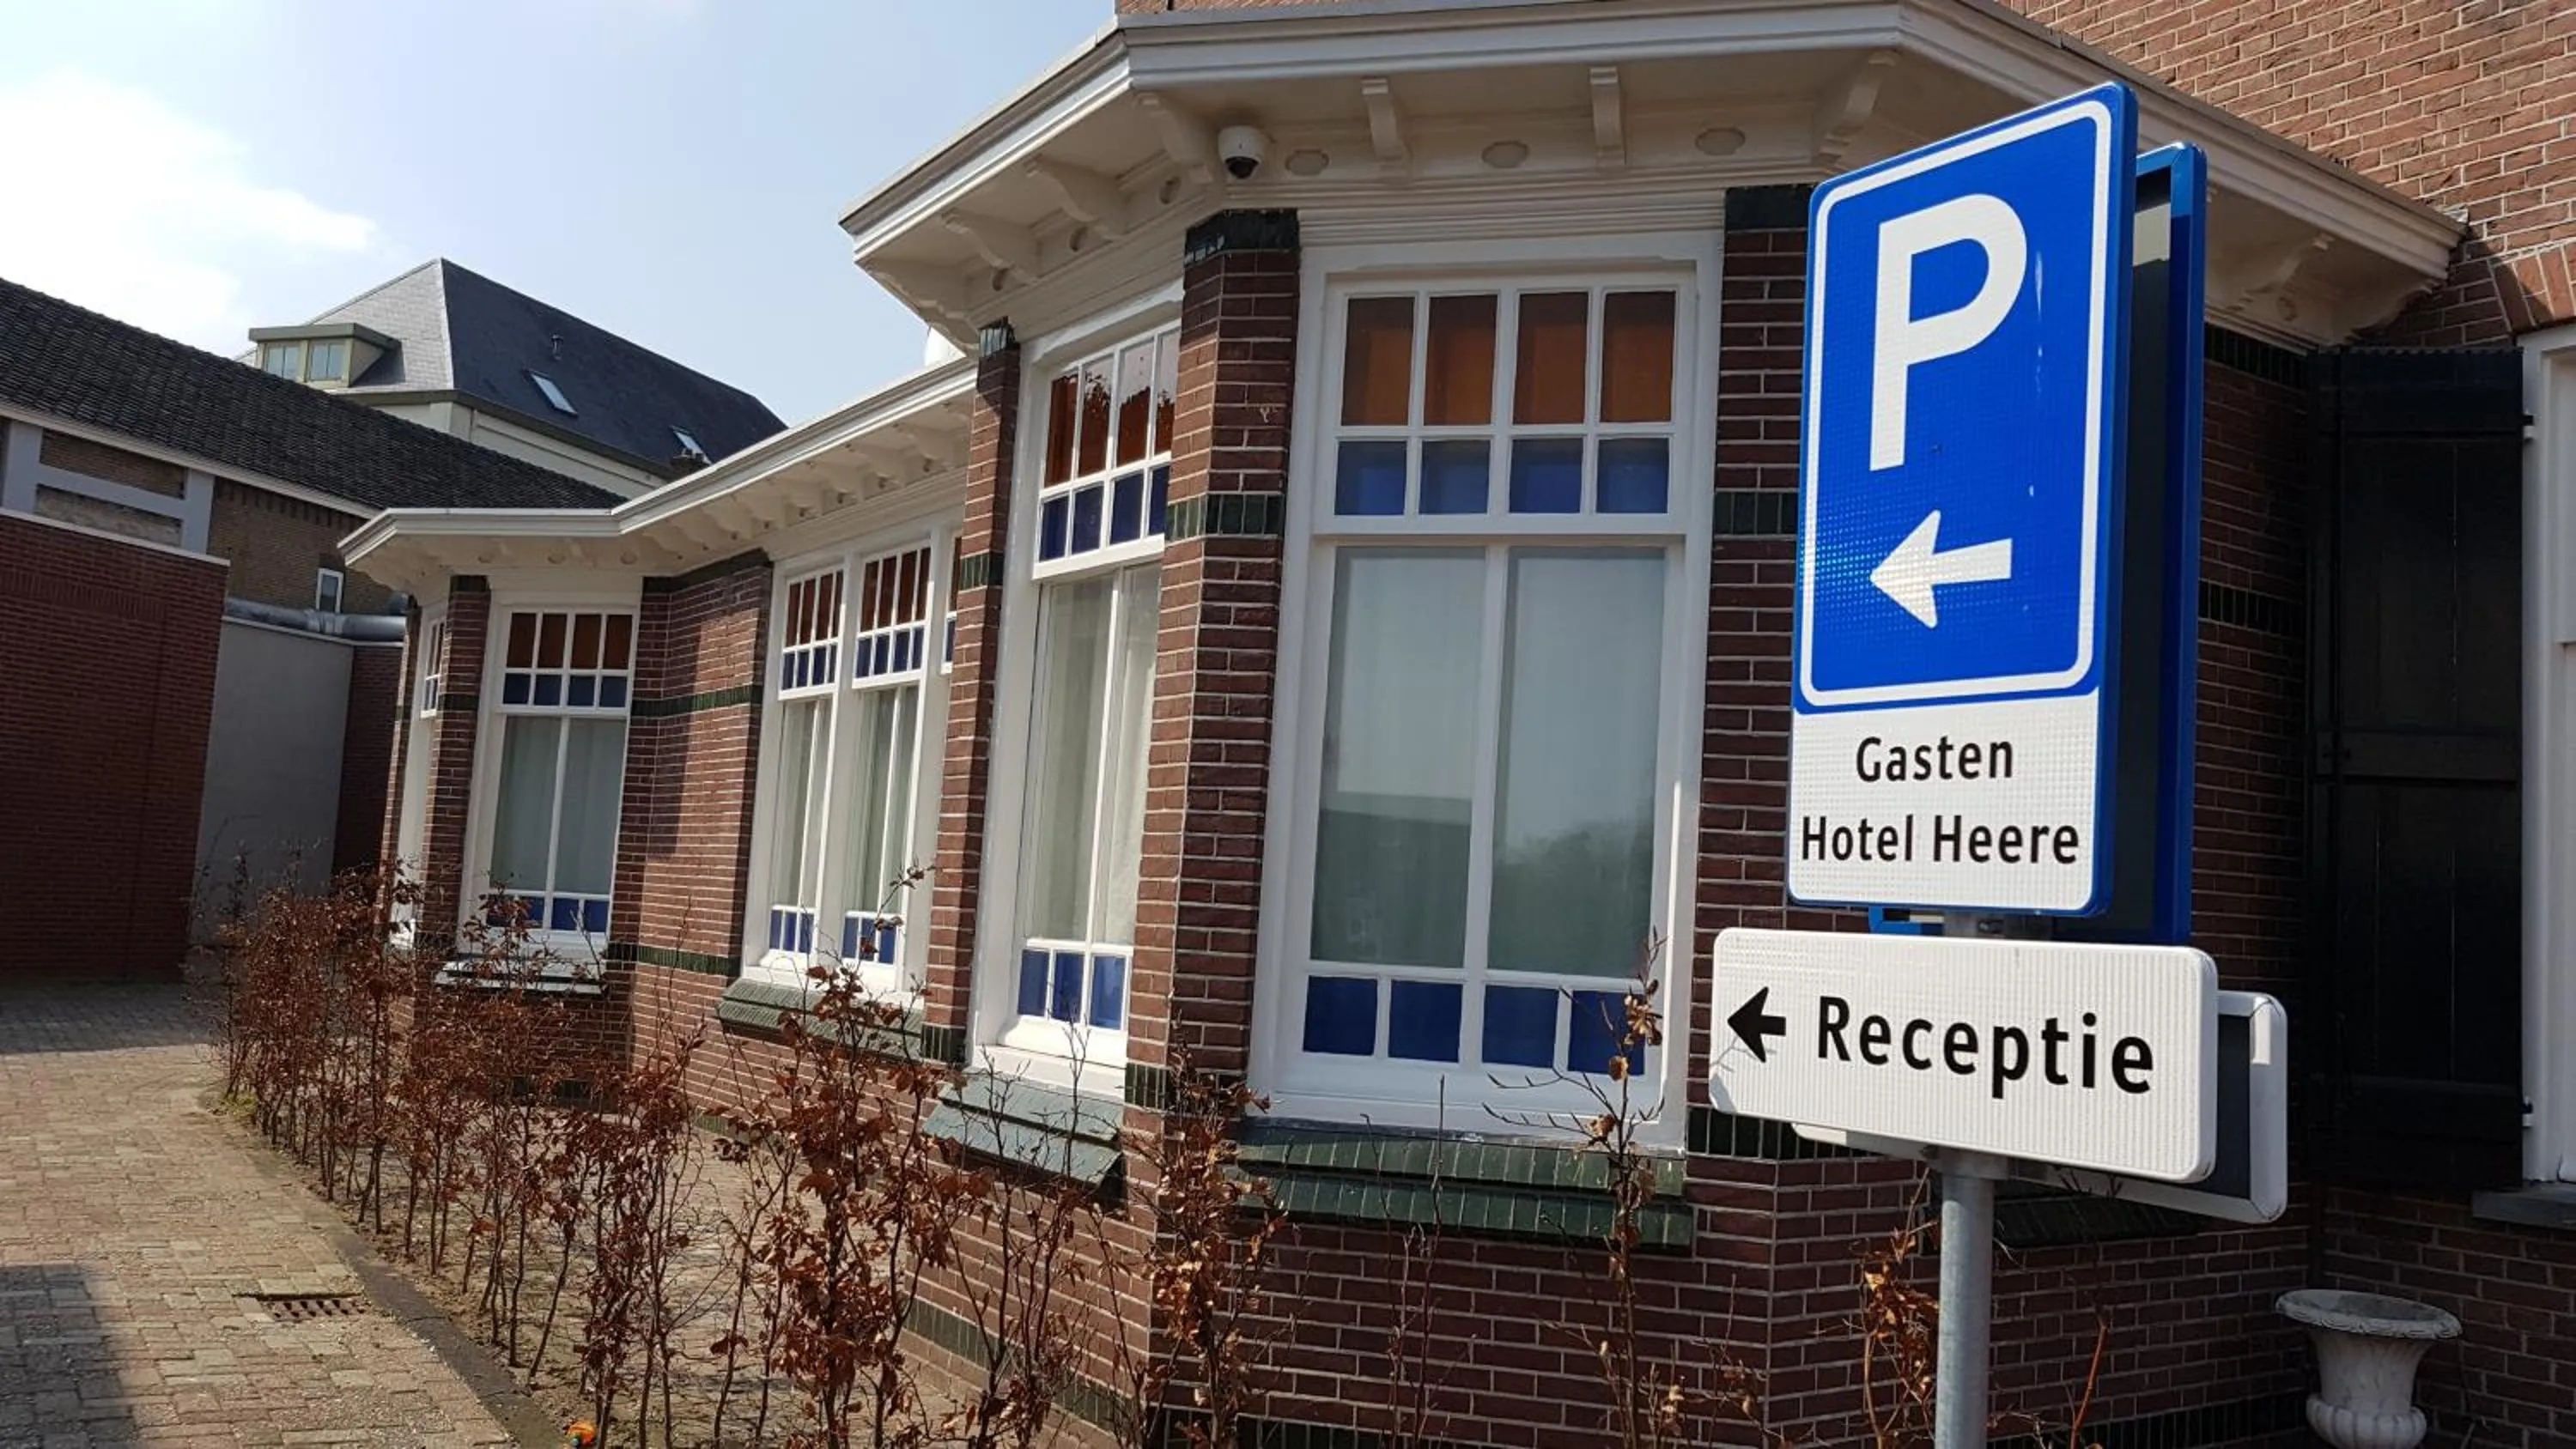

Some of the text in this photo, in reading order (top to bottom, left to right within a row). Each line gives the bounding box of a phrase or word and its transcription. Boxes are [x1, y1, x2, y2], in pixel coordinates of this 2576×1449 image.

[1870, 193, 2027, 471] P
[1856, 735, 2014, 782] Gasten
[1801, 814, 2080, 864] Hotel Heere
[1818, 995, 2154, 1100] Receptie
